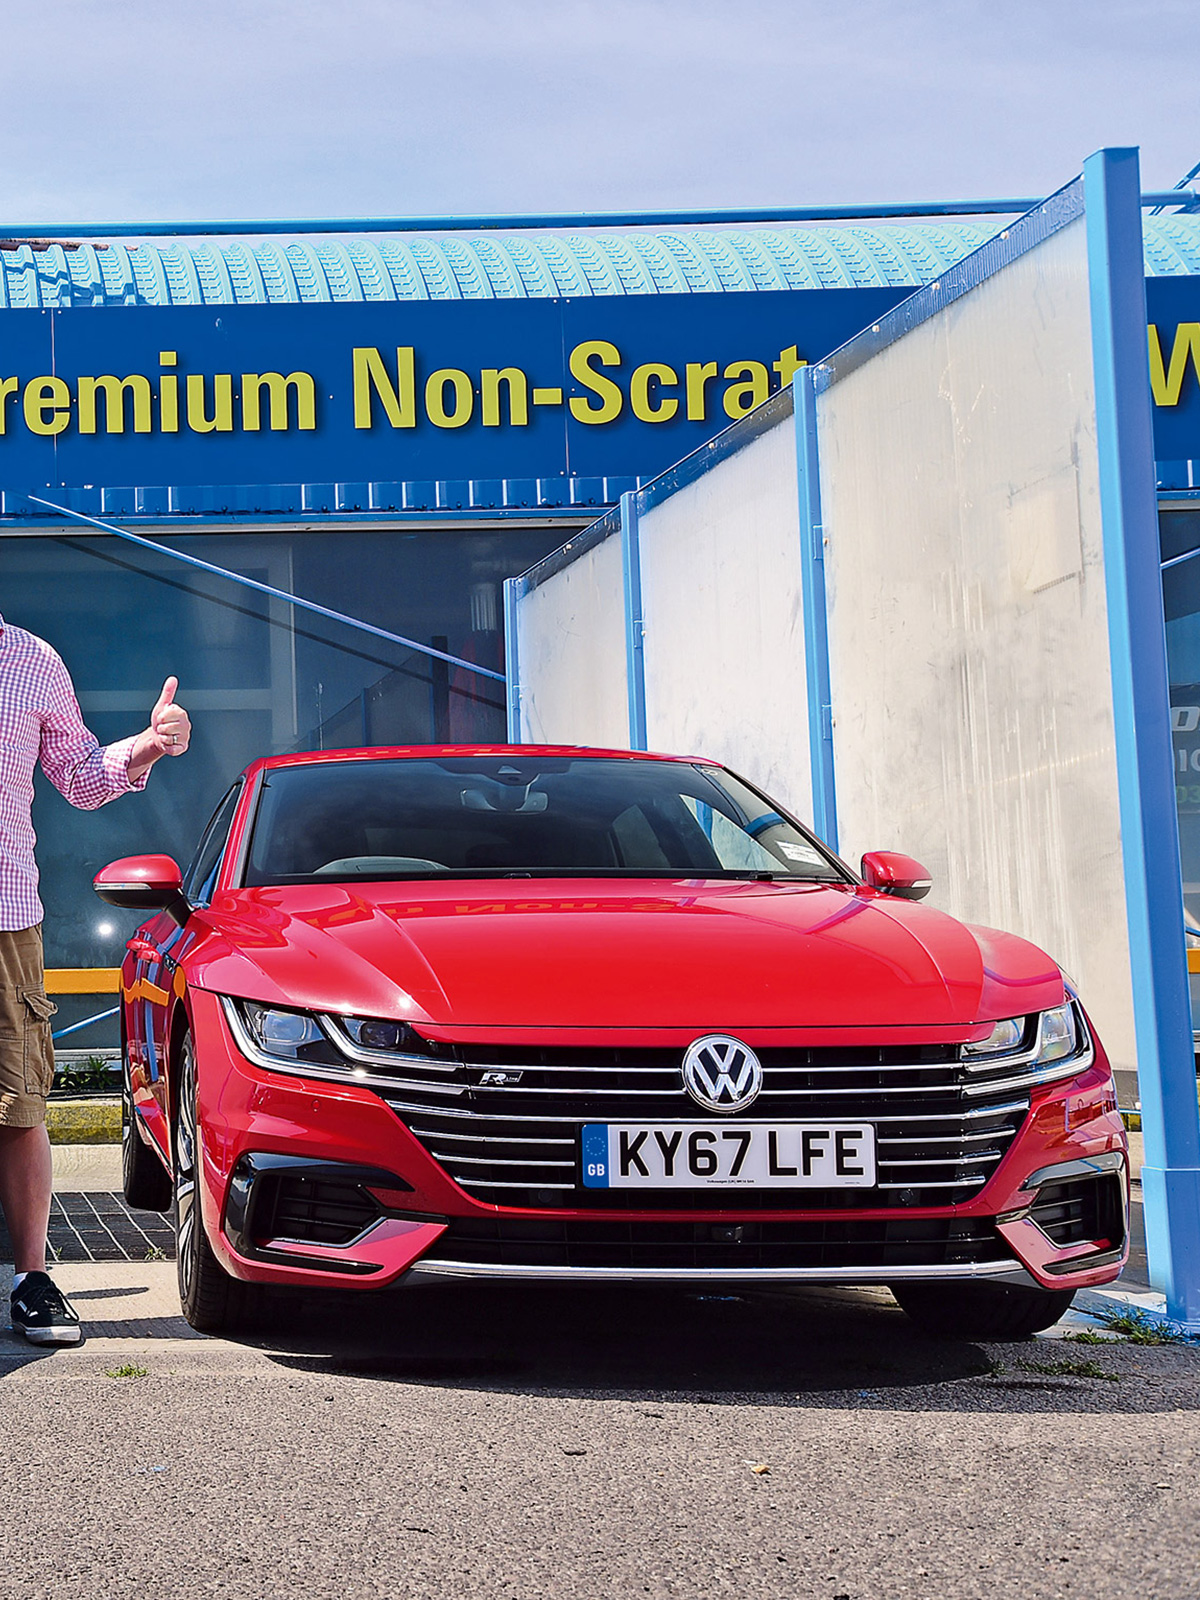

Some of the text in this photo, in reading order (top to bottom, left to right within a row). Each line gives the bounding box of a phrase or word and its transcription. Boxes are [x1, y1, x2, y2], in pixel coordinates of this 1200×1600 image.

[619, 1130, 864, 1177] KY67 LFE
[587, 1163, 606, 1177] GB
